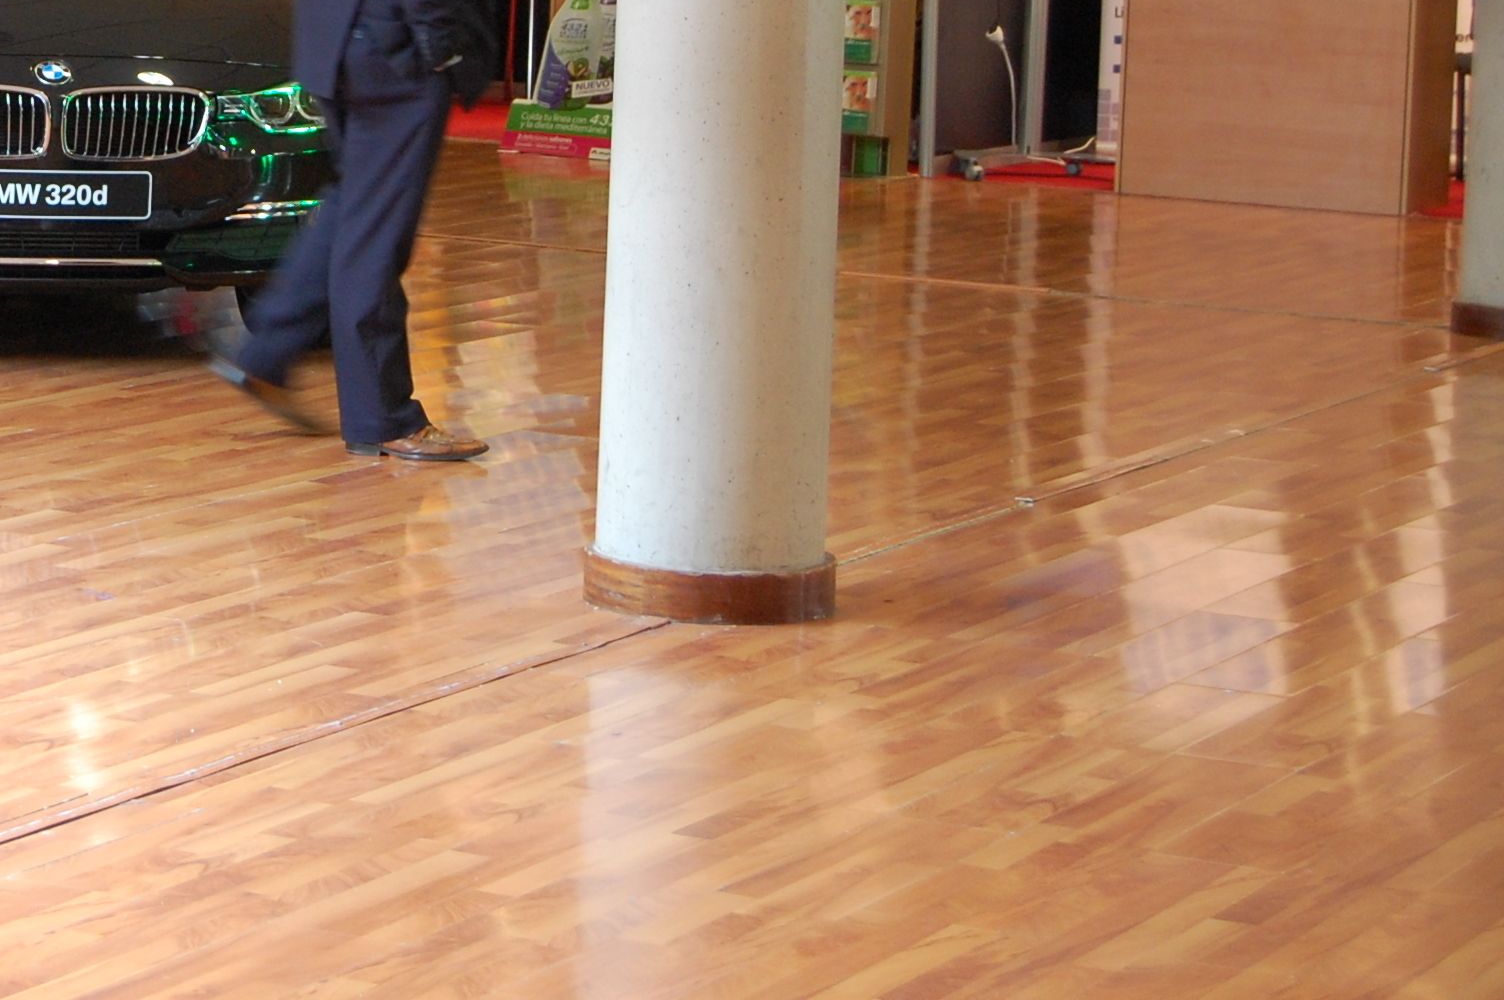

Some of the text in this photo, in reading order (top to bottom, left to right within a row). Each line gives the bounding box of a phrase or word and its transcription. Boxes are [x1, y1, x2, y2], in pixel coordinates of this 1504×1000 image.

[575, 79, 610, 91] NUEVO
[589, 113, 613, 126] 43
[45, 184, 109, 206] 320d
